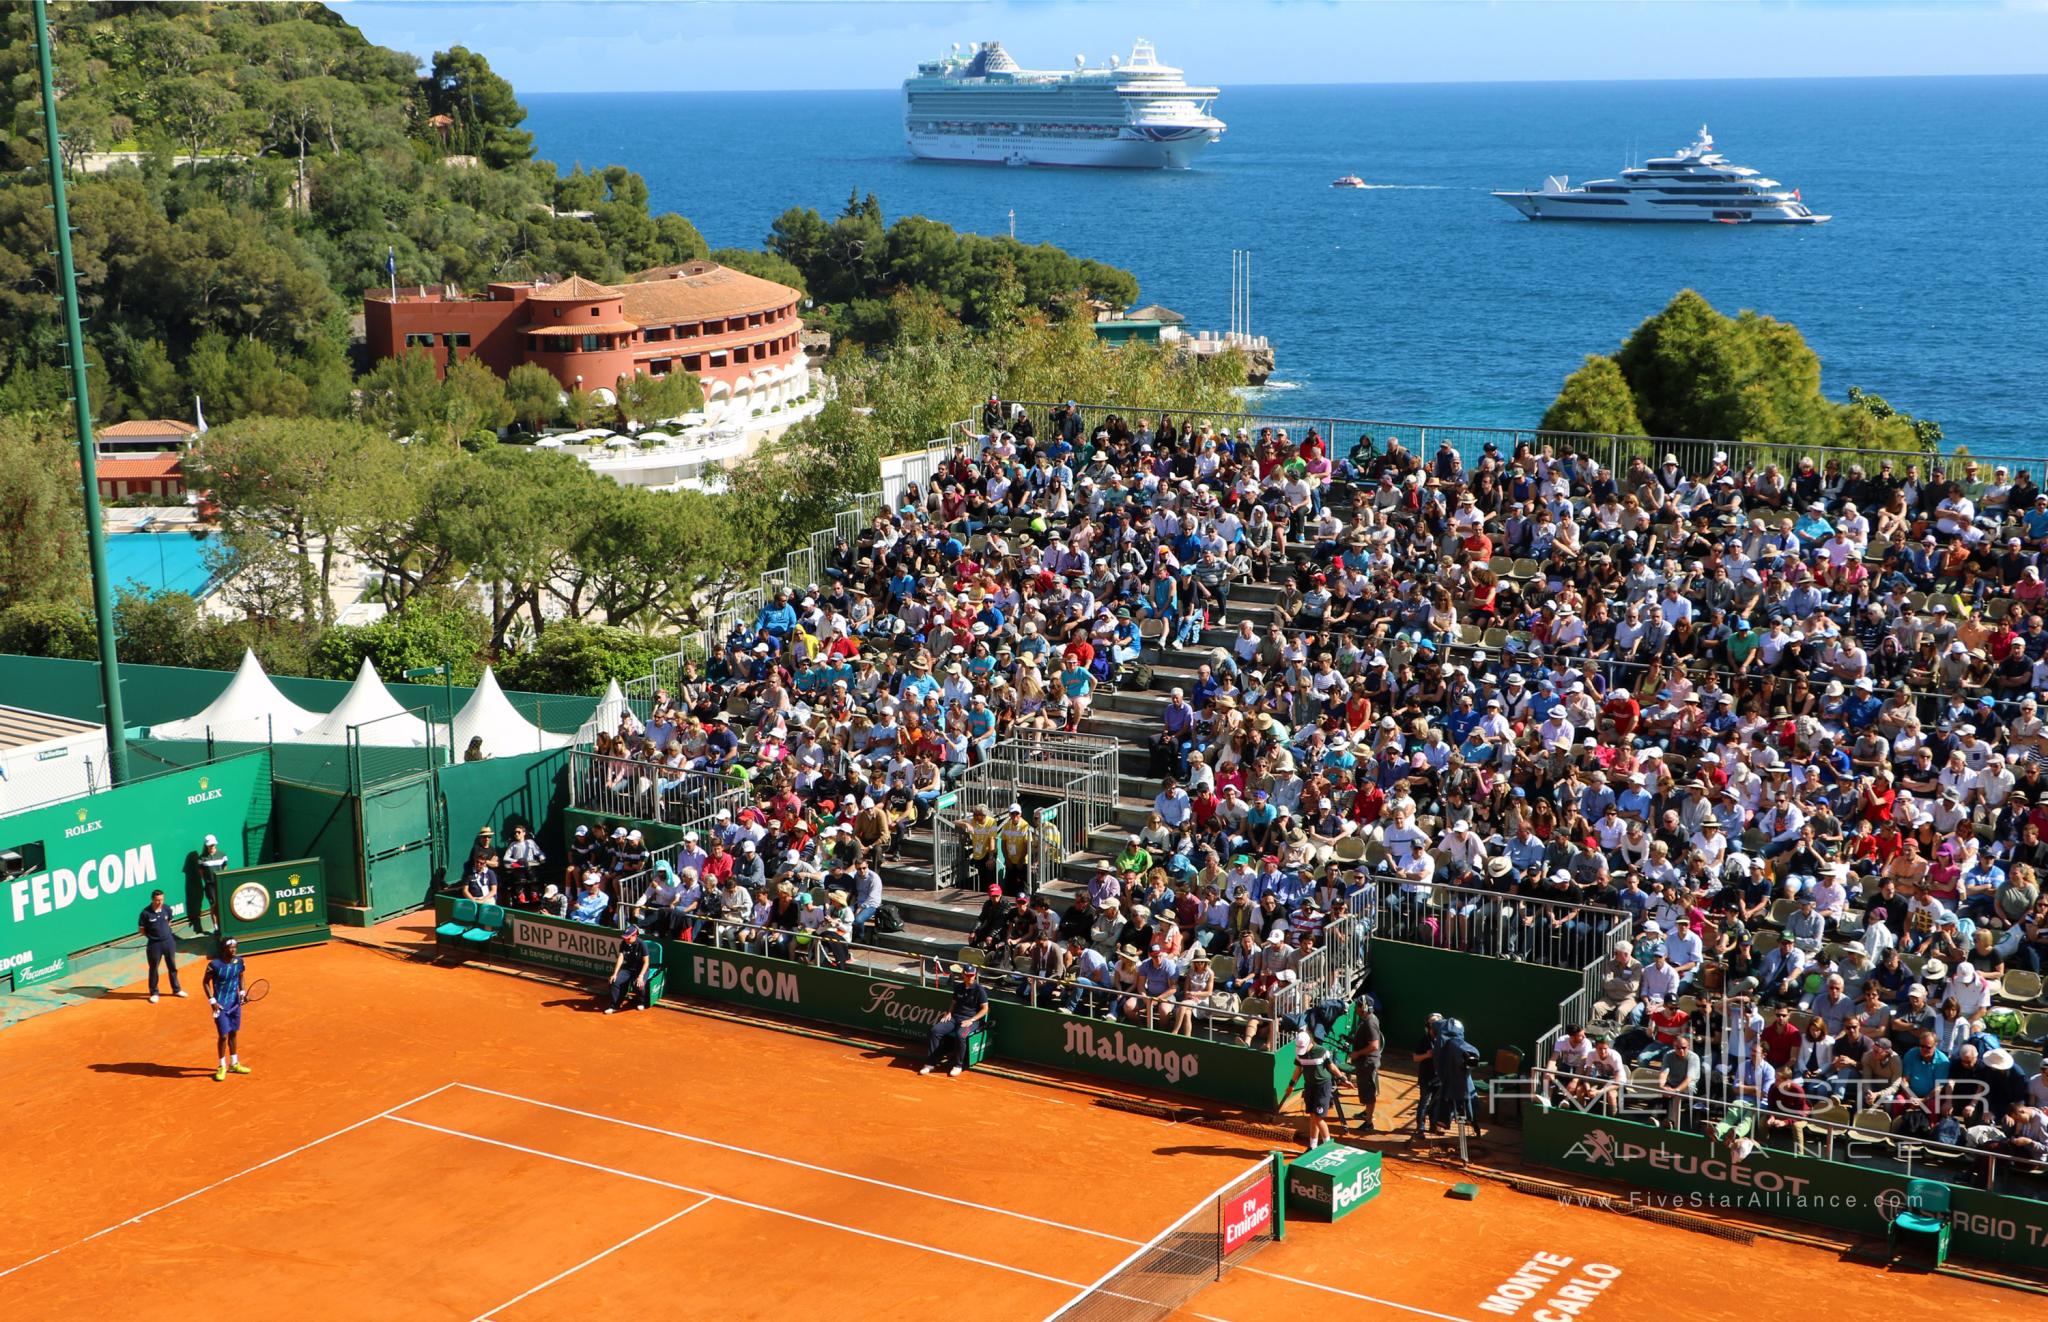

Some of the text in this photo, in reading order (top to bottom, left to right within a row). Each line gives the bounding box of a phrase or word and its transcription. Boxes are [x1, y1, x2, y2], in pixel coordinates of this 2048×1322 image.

[187, 788, 222, 805] ROLEX
[65, 820, 103, 838] ROLEX
[11, 844, 157, 923] FEDCOM
[275, 886, 315, 899] ROLEX
[278, 898, 314, 917] 0:26
[520, 924, 553, 945] BNP
[693, 955, 800, 1003] FEDCOM
[1063, 1021, 1199, 1084] Malongo
[1332, 1166, 1381, 1213] FedEx
[1623, 1142, 1810, 1197] PEUGEOT
[1243, 1197, 1257, 1216] Fly
[1290, 1178, 1332, 1204] FedEx
[1226, 1204, 1270, 1244] Emirates
[1478, 1251, 1574, 1316] MONTE
[1533, 1263, 1622, 1322] CARLO
